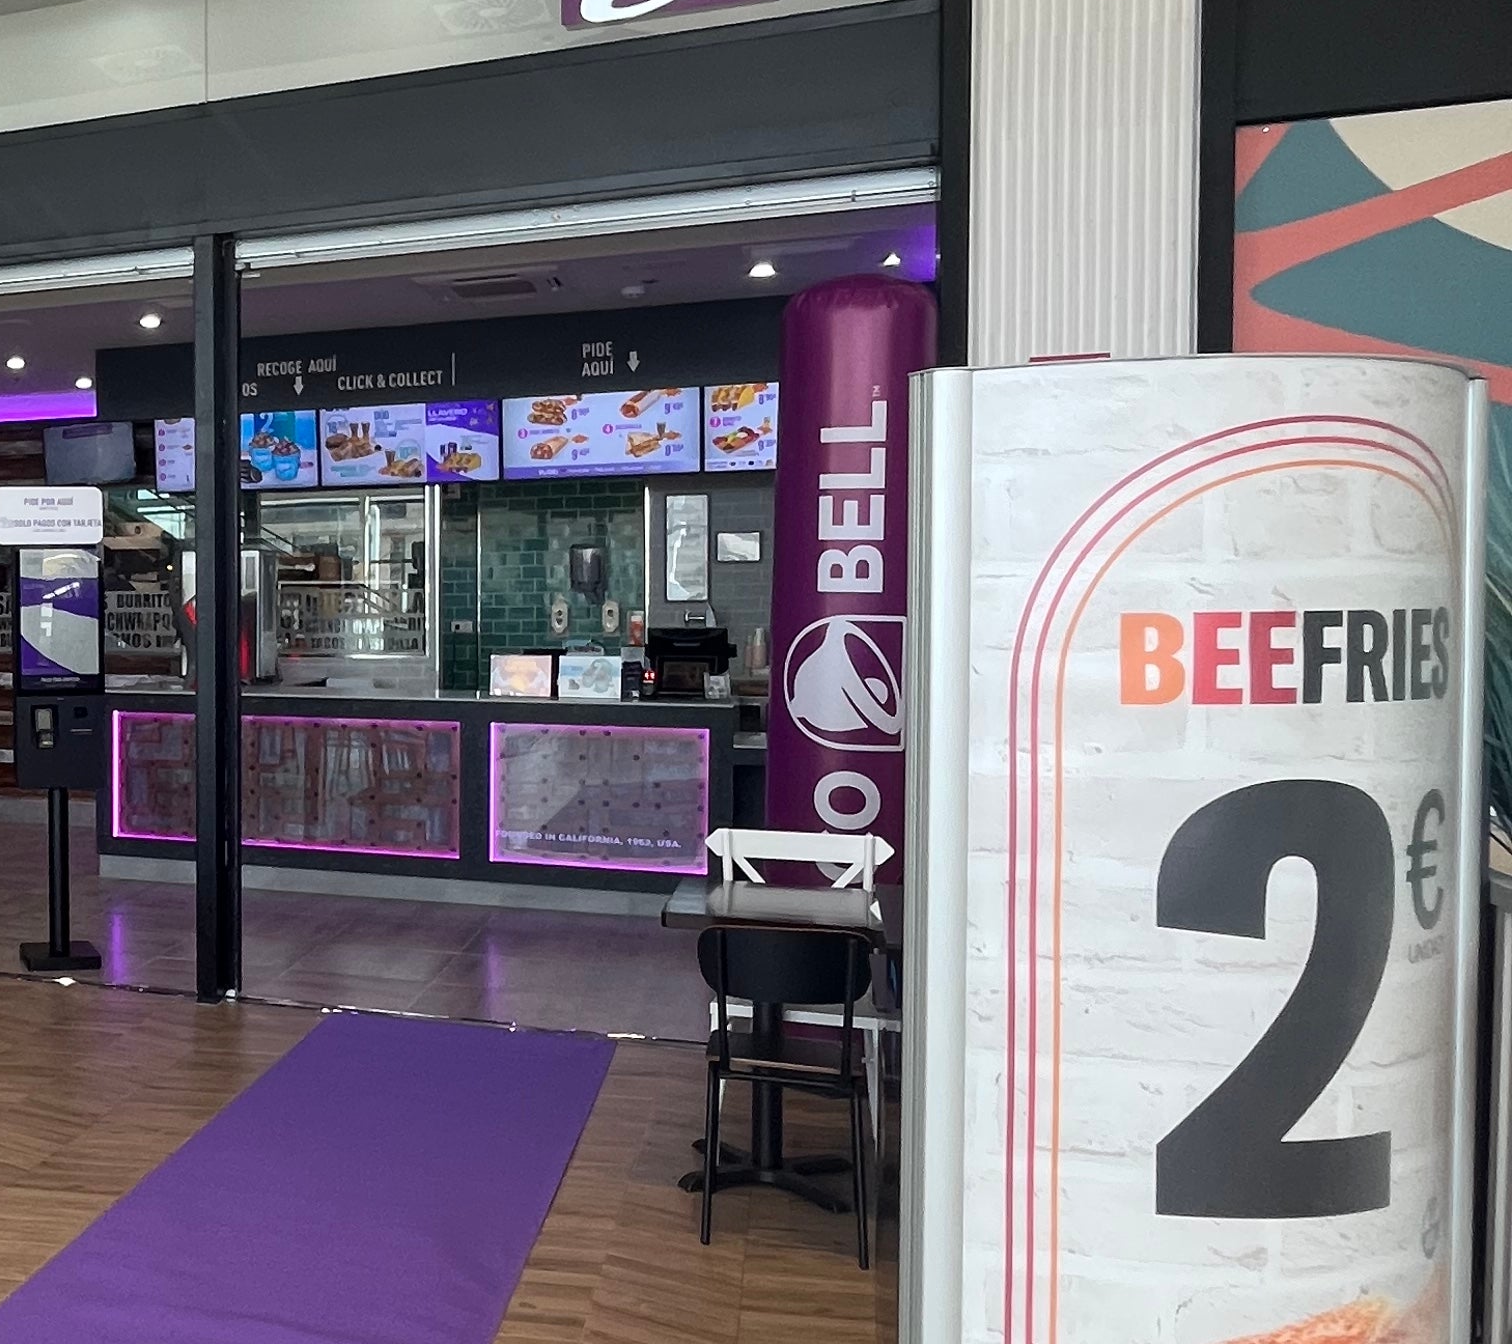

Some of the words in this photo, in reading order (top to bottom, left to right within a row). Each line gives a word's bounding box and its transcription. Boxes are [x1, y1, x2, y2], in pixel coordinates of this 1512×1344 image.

[582, 341, 613, 359] PIDE
[257, 360, 303, 377] RECOGE
[308, 354, 337, 374] AQUÍ
[581, 356, 615, 377] AQUÍ
[337, 374, 374, 391] CLICK
[376, 373, 387, 389] &
[388, 370, 444, 388] COLLECT
[41, 497, 55, 505] POR
[817, 400, 887, 593] BELL
[57, 519, 71, 527] CON
[1120, 606, 1450, 705] BEEFRIES
[545, 833, 556, 841] IN
[558, 834, 623, 845] CALIFORNIA,
